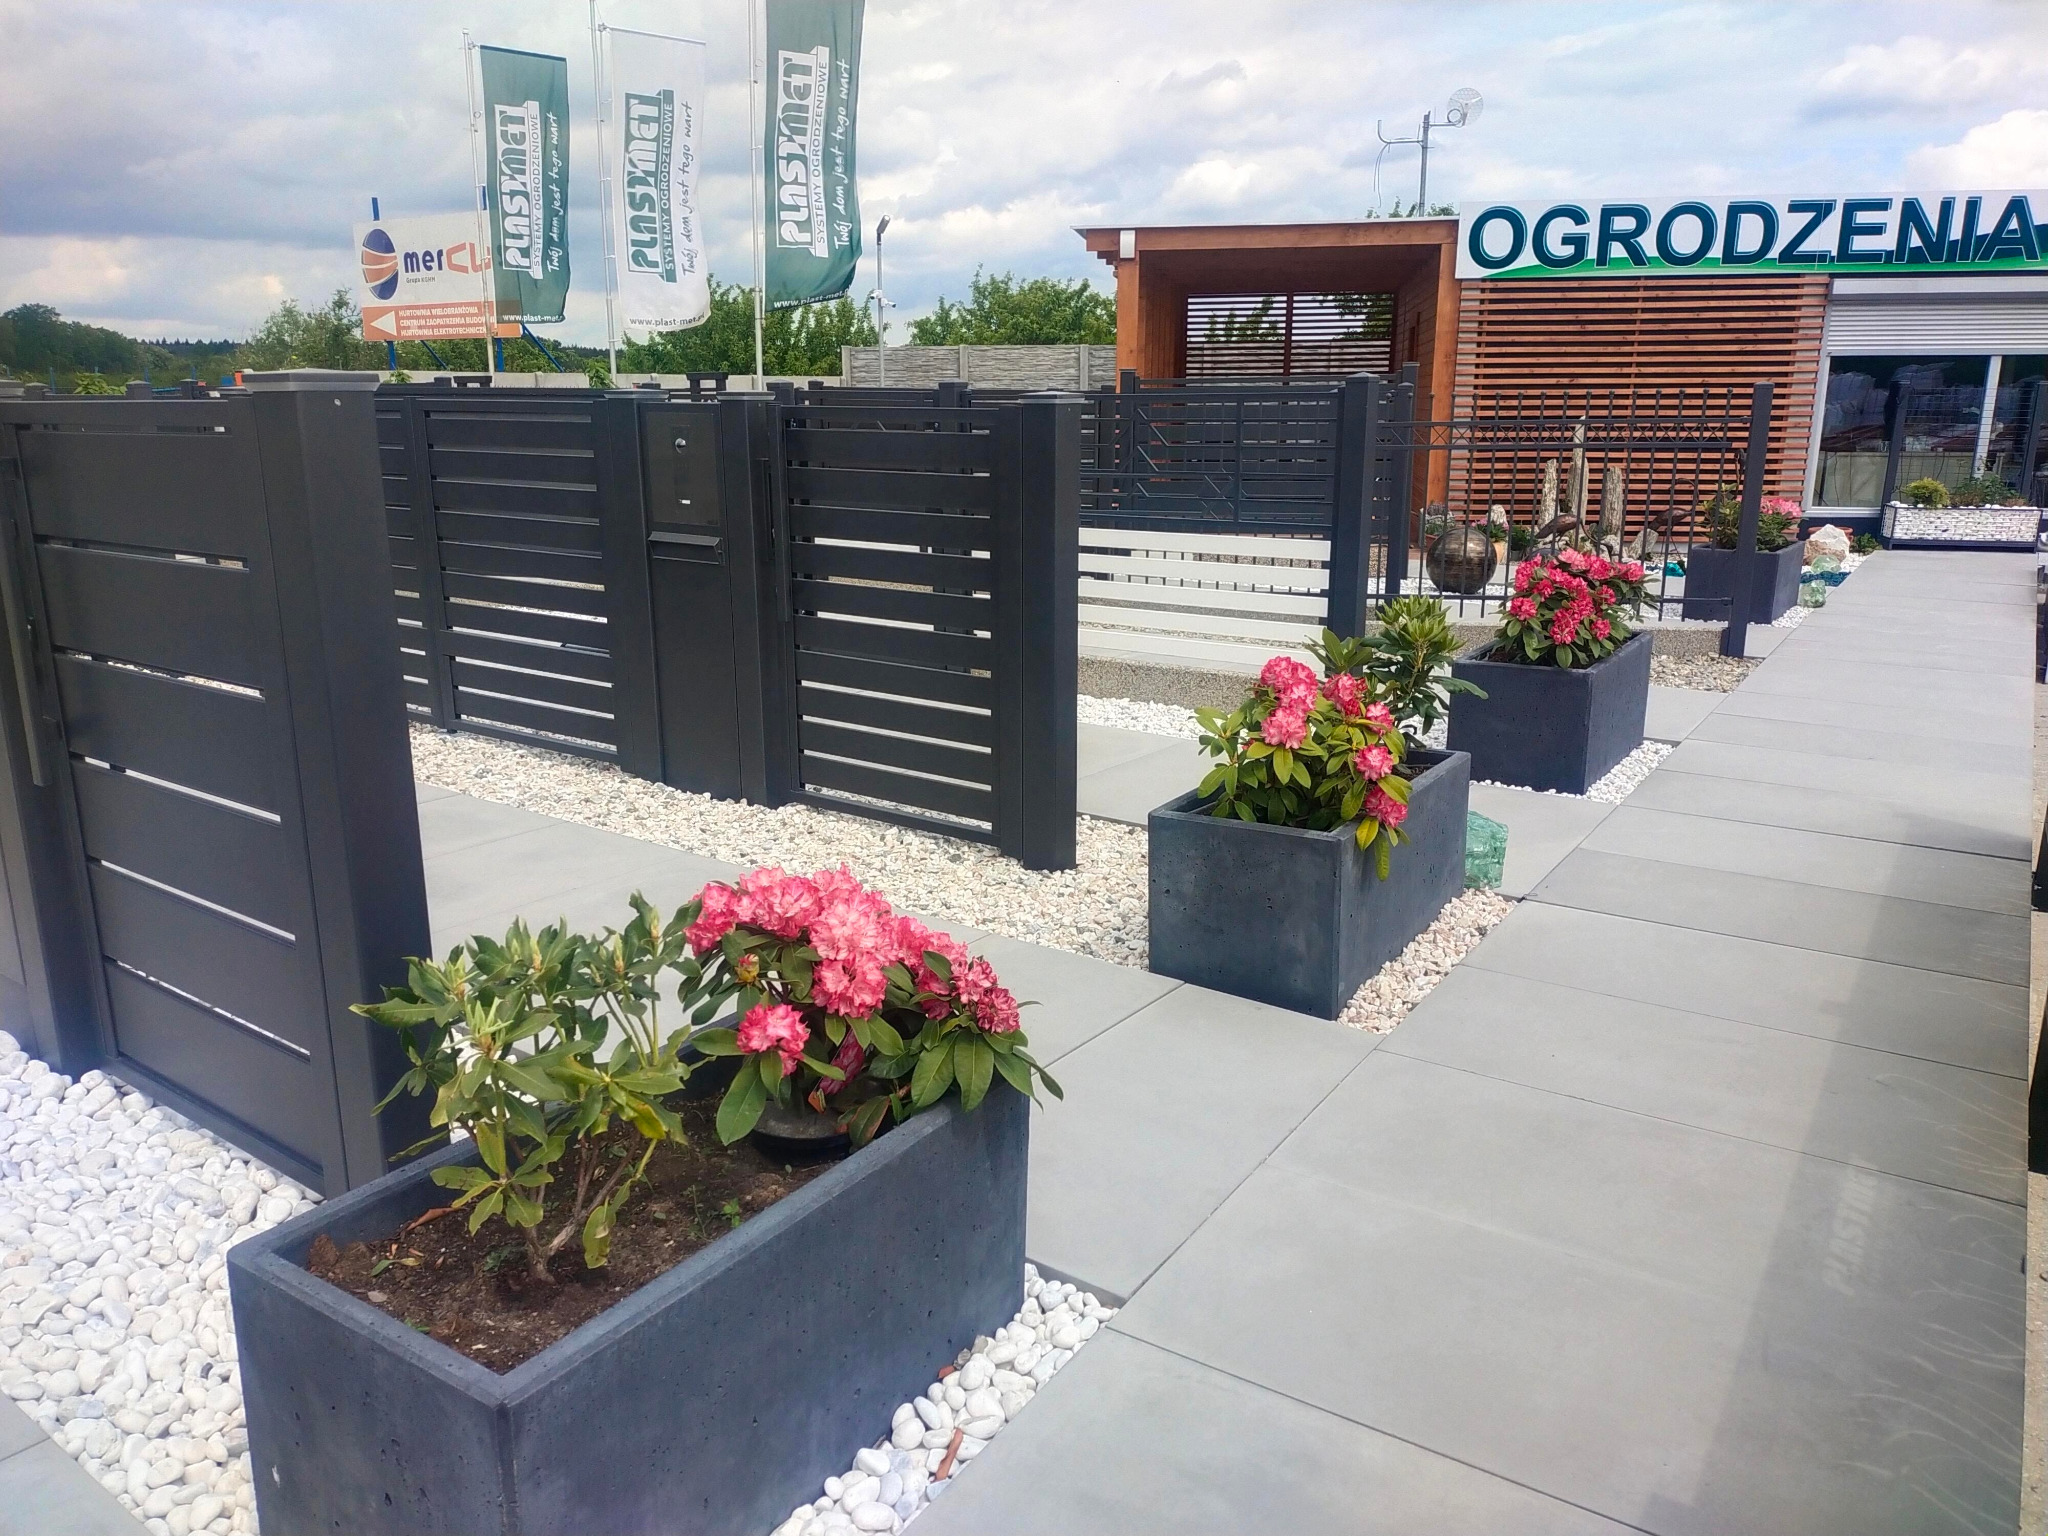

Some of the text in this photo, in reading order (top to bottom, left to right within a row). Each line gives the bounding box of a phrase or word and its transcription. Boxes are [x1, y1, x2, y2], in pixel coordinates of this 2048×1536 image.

[546, 111, 559, 145] wart
[680, 101, 693, 138] wart
[549, 149, 563, 179] tego
[678, 144, 694, 175] tego
[812, 61, 828, 244] SYSTEMY OGRODZENIOWE
[831, 58, 853, 250] Twój dom jest tego wart
[530, 113, 542, 267] SYSTEMY OGRODZENIOWE
[548, 184, 564, 216] jest
[661, 102, 675, 270] SYSTEMY OGRODZENIOWE
[677, 180, 695, 214] jest
[1468, 196, 2040, 269] OGRODZENIA
[548, 249, 563, 273] Twój
[682, 248, 699, 276] Twój
[400, 319, 426, 327] CENTRUM
[401, 328, 433, 336] HURTOWNIA
